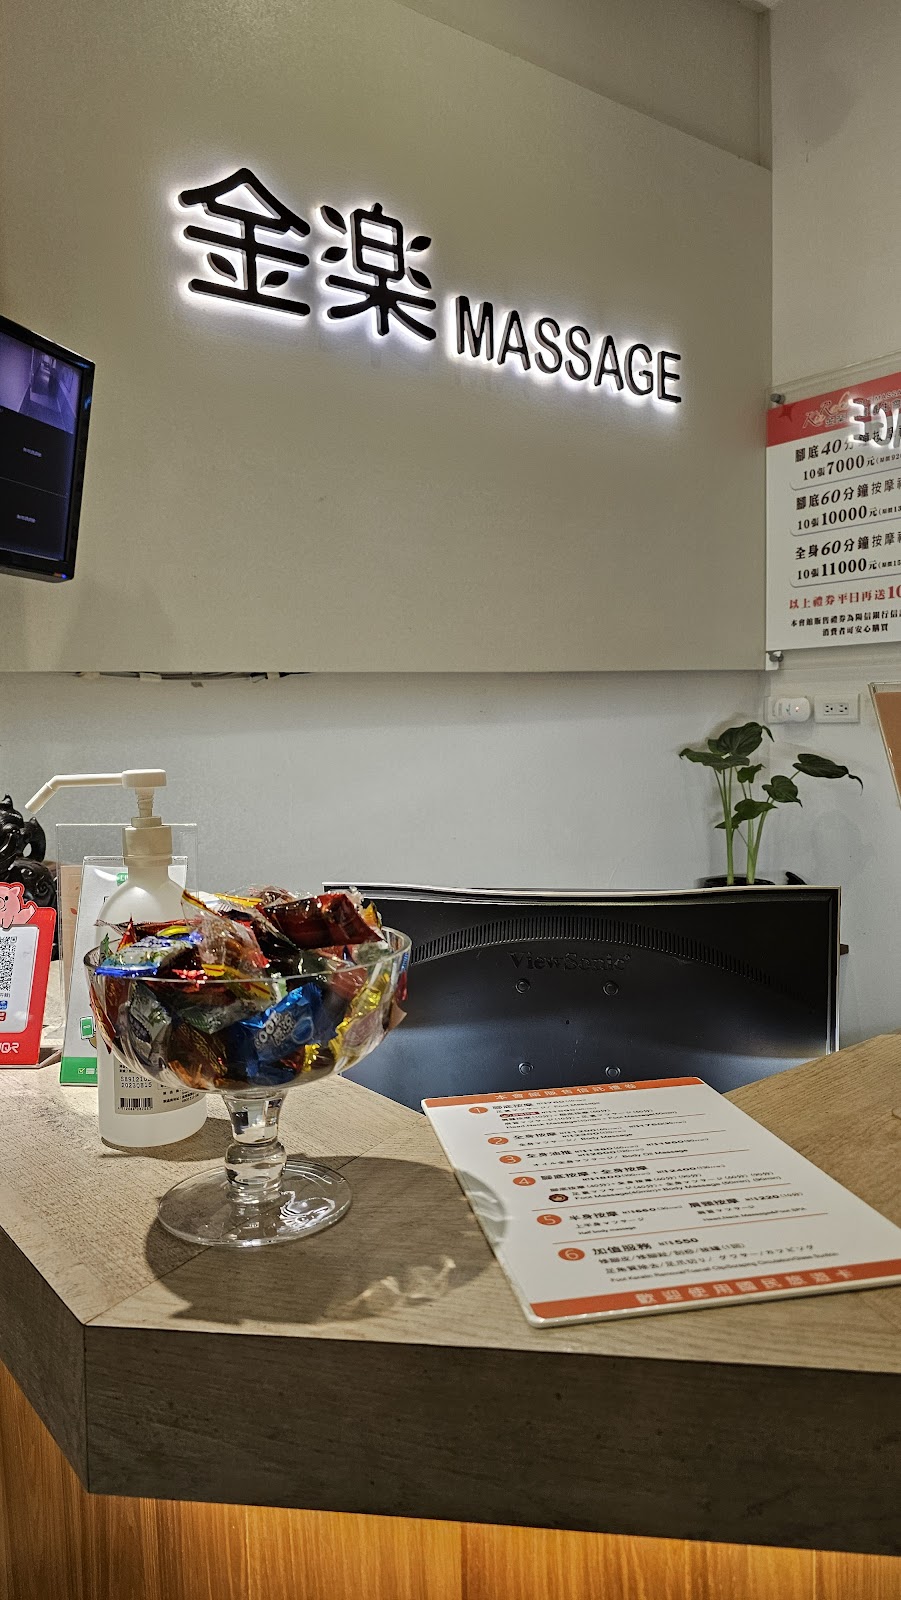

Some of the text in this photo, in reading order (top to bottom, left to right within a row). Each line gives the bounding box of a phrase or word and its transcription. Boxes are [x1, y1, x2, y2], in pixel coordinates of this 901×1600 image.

[455, 295, 682, 404] MASSAGE
[508, 951, 627, 973] ViewSonic
[569, 1211, 618, 1221] 半身按摩
[564, 1249, 578, 1260] 6
[592, 1242, 652, 1256] 加值服務
